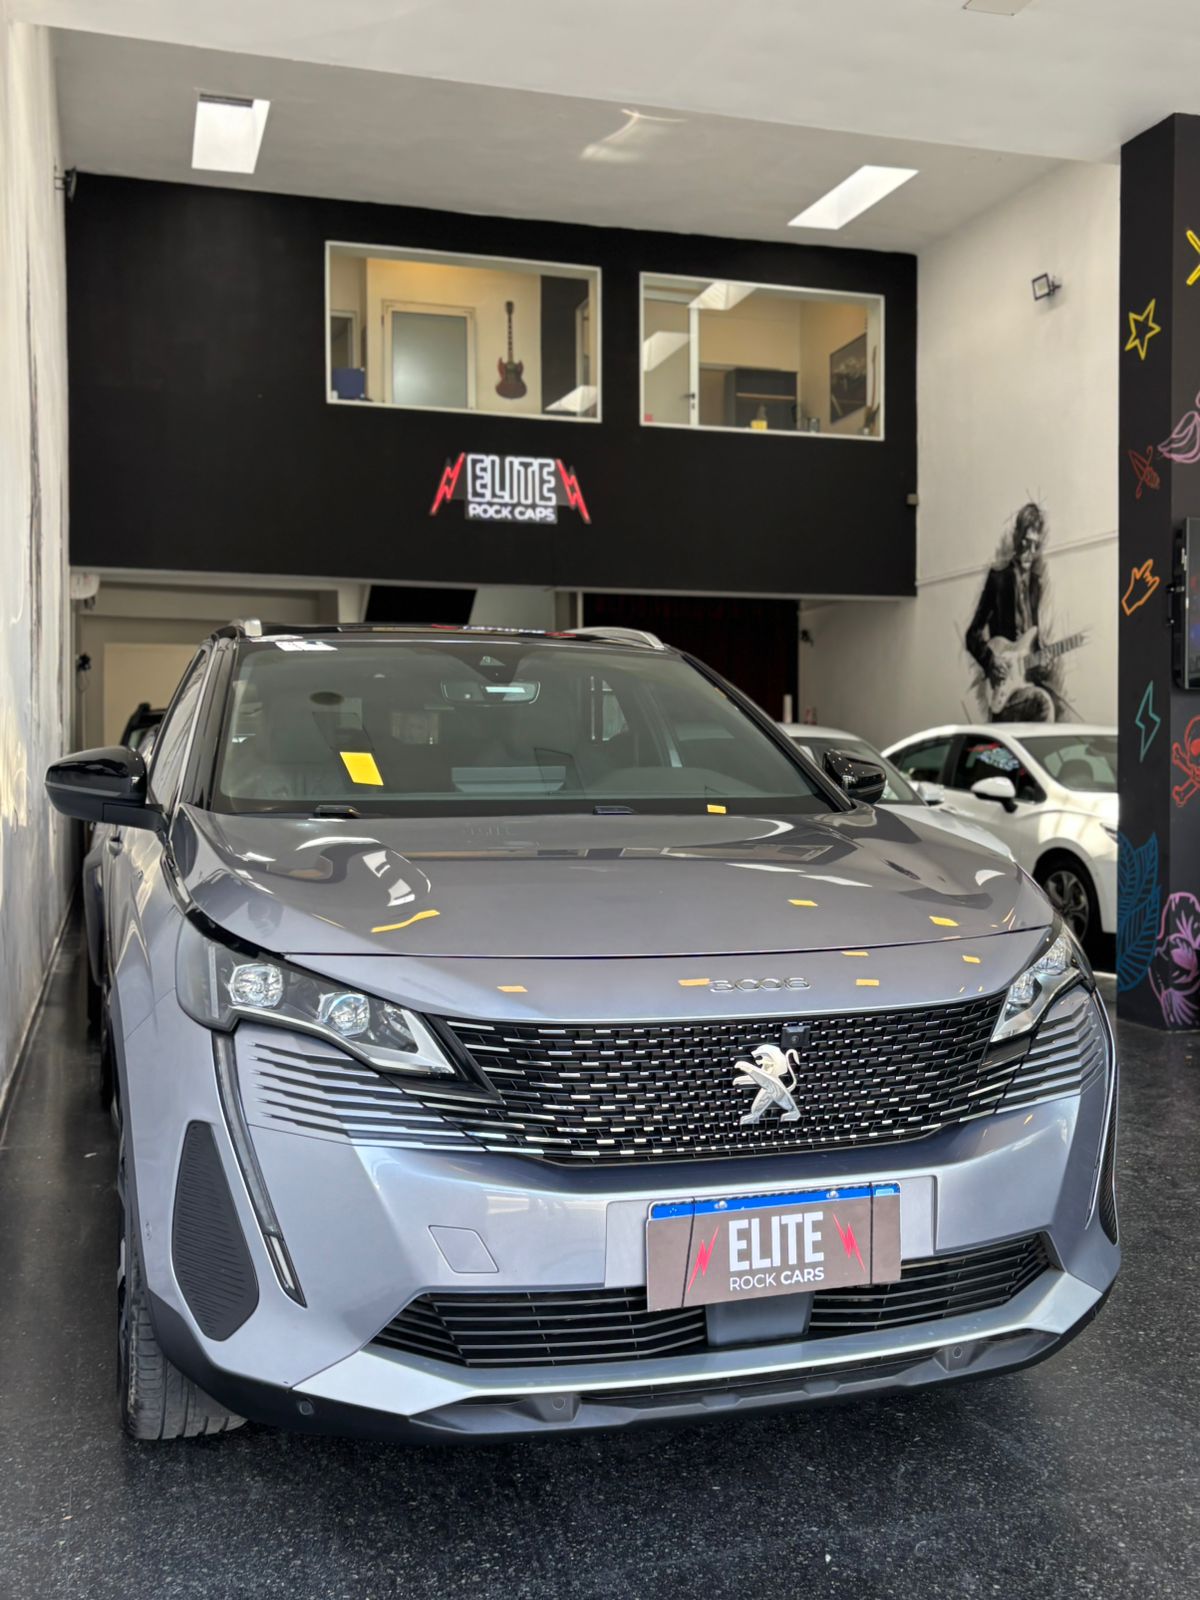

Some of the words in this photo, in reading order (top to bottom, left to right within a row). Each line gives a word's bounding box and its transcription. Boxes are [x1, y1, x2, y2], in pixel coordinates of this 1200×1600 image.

[467, 455, 556, 505] ELITE
[709, 977, 811, 993] 3008
[728, 1211, 825, 1272] ELITE
[729, 1272, 777, 1292] ROCK
[780, 1266, 825, 1285] CARS
